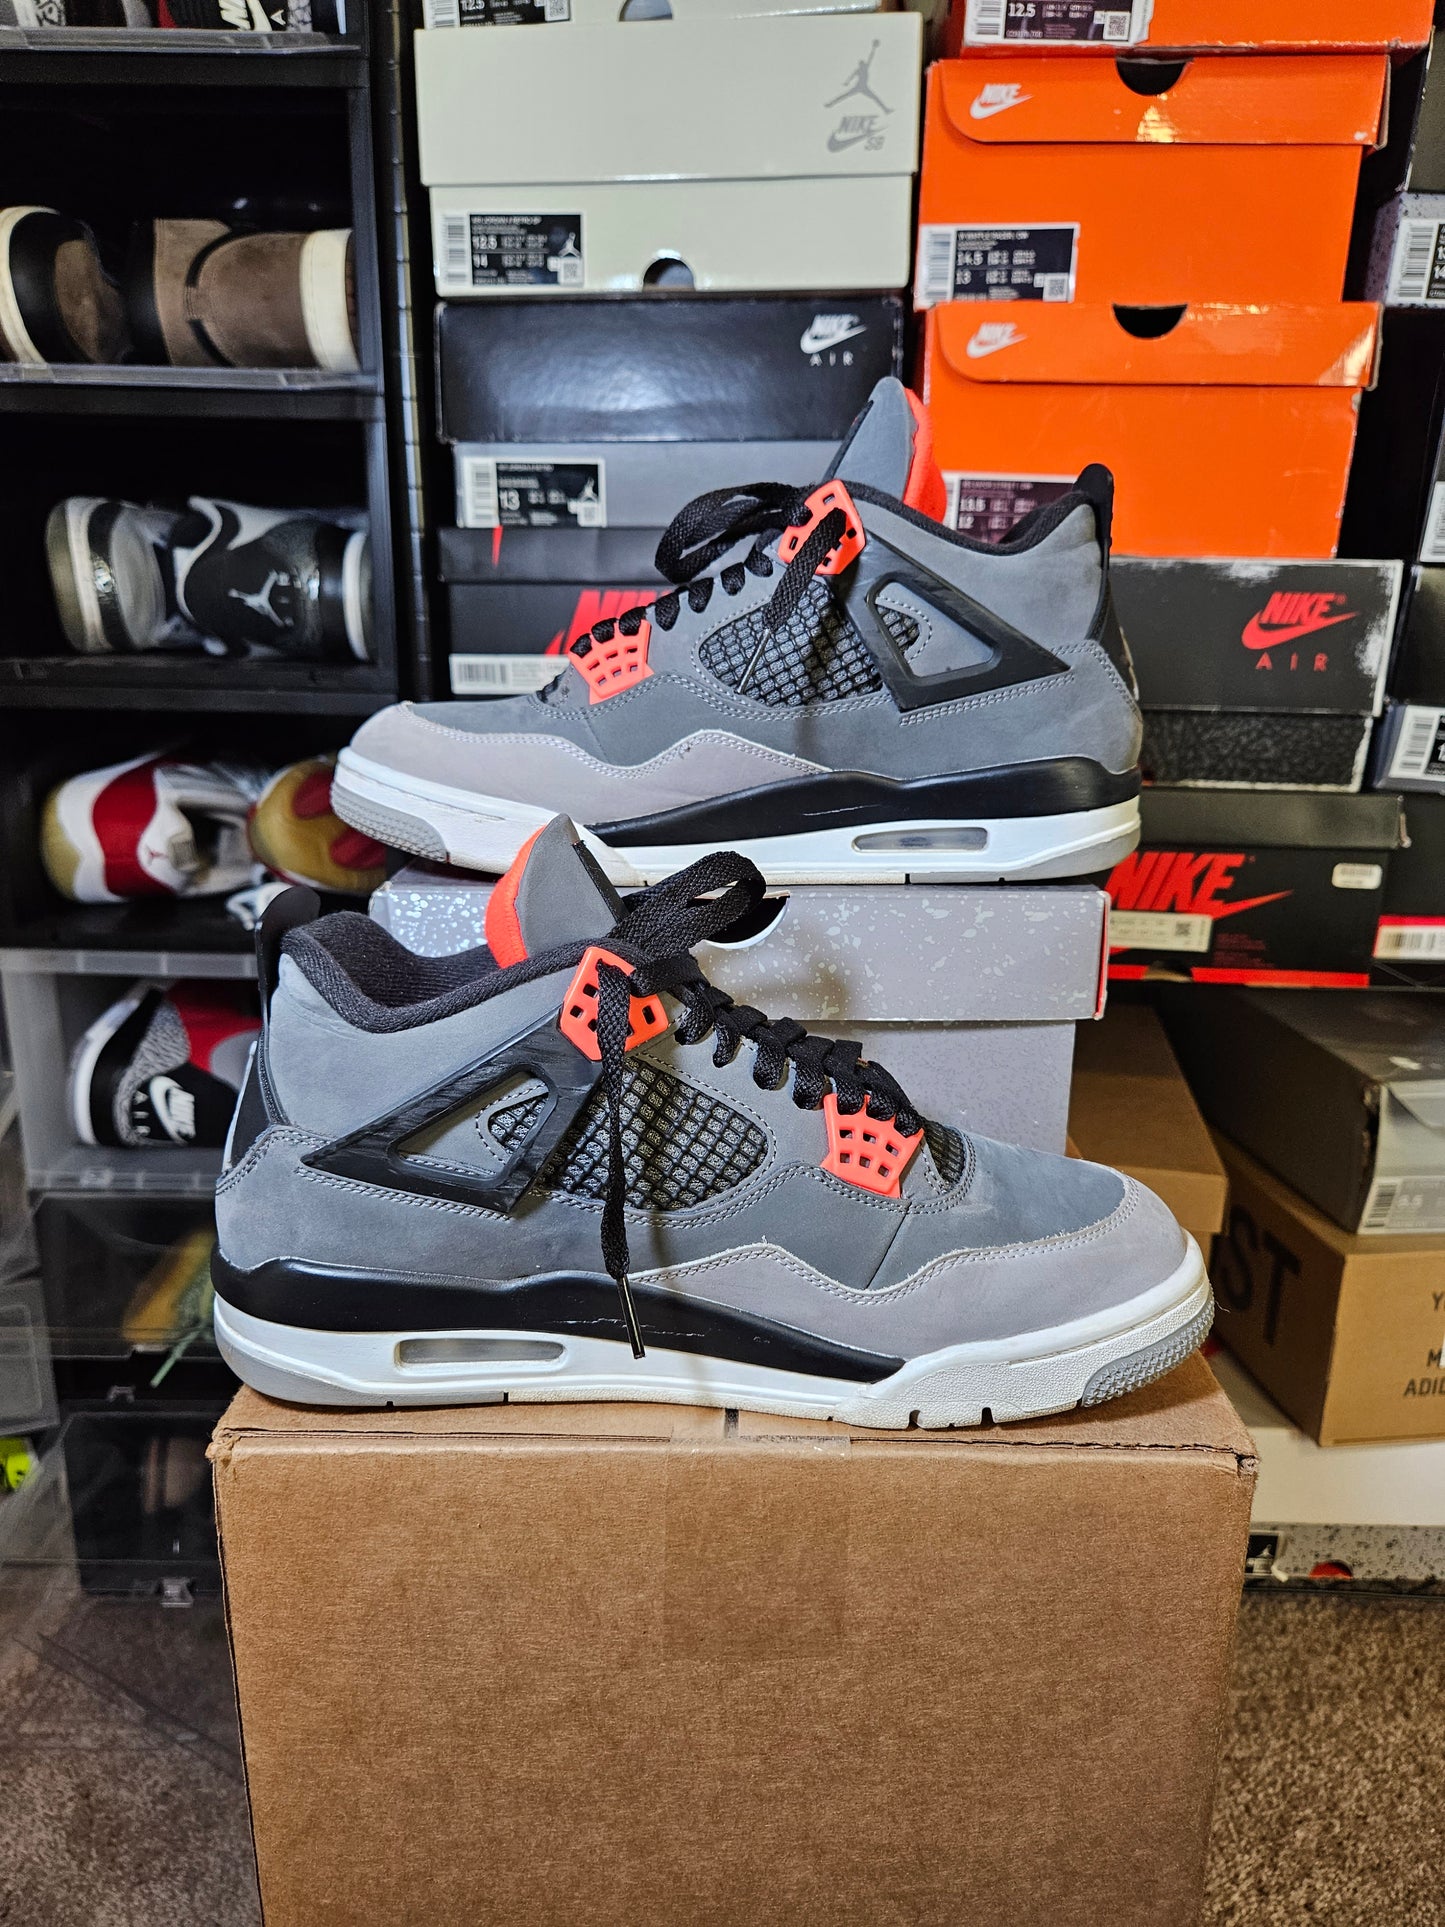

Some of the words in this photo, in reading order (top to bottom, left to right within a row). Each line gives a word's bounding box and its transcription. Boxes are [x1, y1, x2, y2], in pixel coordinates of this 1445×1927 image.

[1007, 3, 1036, 18] 12.5
[978, 83, 1022, 104] NIKE
[839, 115, 880, 135] NIKE
[863, 135, 886, 151] SB
[807, 313, 860, 337] NIKE
[976, 322, 1019, 344] NIKE
[808, 349, 854, 367] AIR
[1257, 591, 1337, 624] NIKE
[1255, 651, 1329, 672] AIR
[1104, 852, 1247, 914] NIKE
